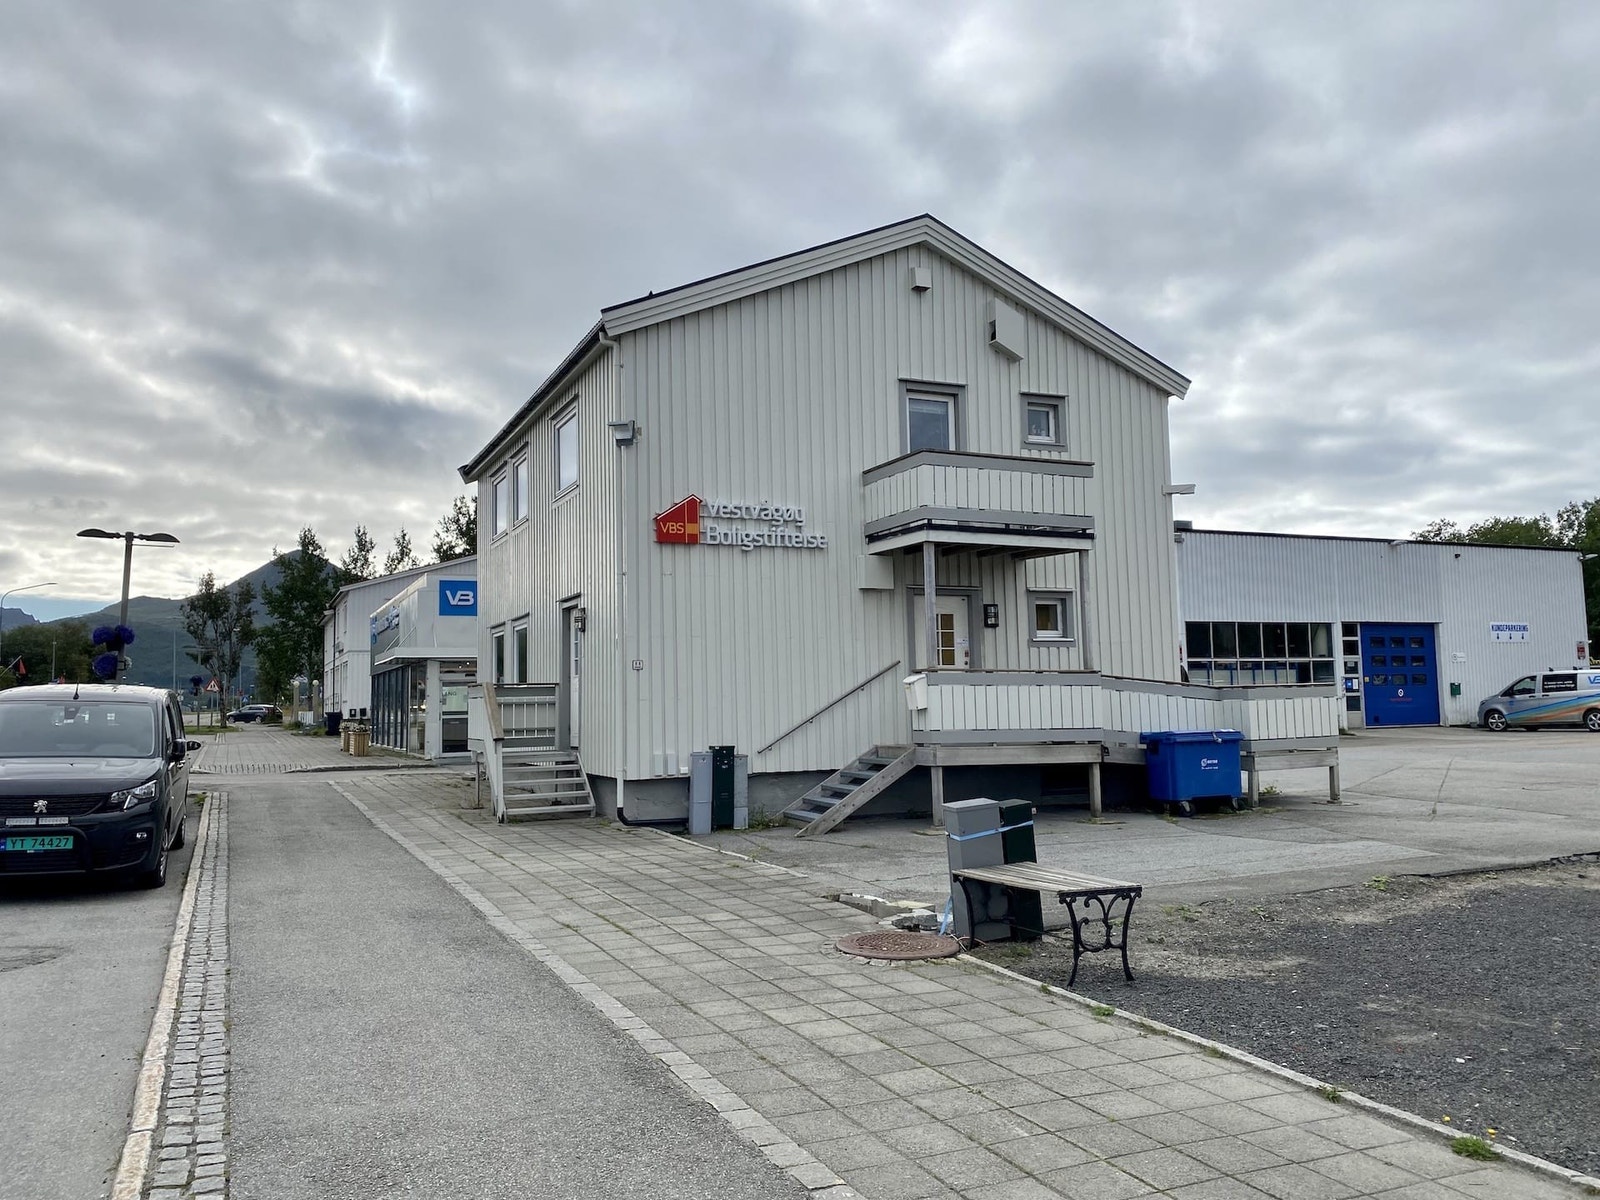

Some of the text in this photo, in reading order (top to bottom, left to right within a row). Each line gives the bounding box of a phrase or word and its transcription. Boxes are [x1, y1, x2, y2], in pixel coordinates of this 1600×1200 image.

[706, 498, 805, 526] Vestvågøy
[660, 521, 685, 534] VBS
[706, 525, 828, 550] Boligstiftelse
[445, 590, 475, 606] VB
[1491, 624, 1529, 632] KUNDEPARKERING
[10, 837, 70, 849] YT 74427
